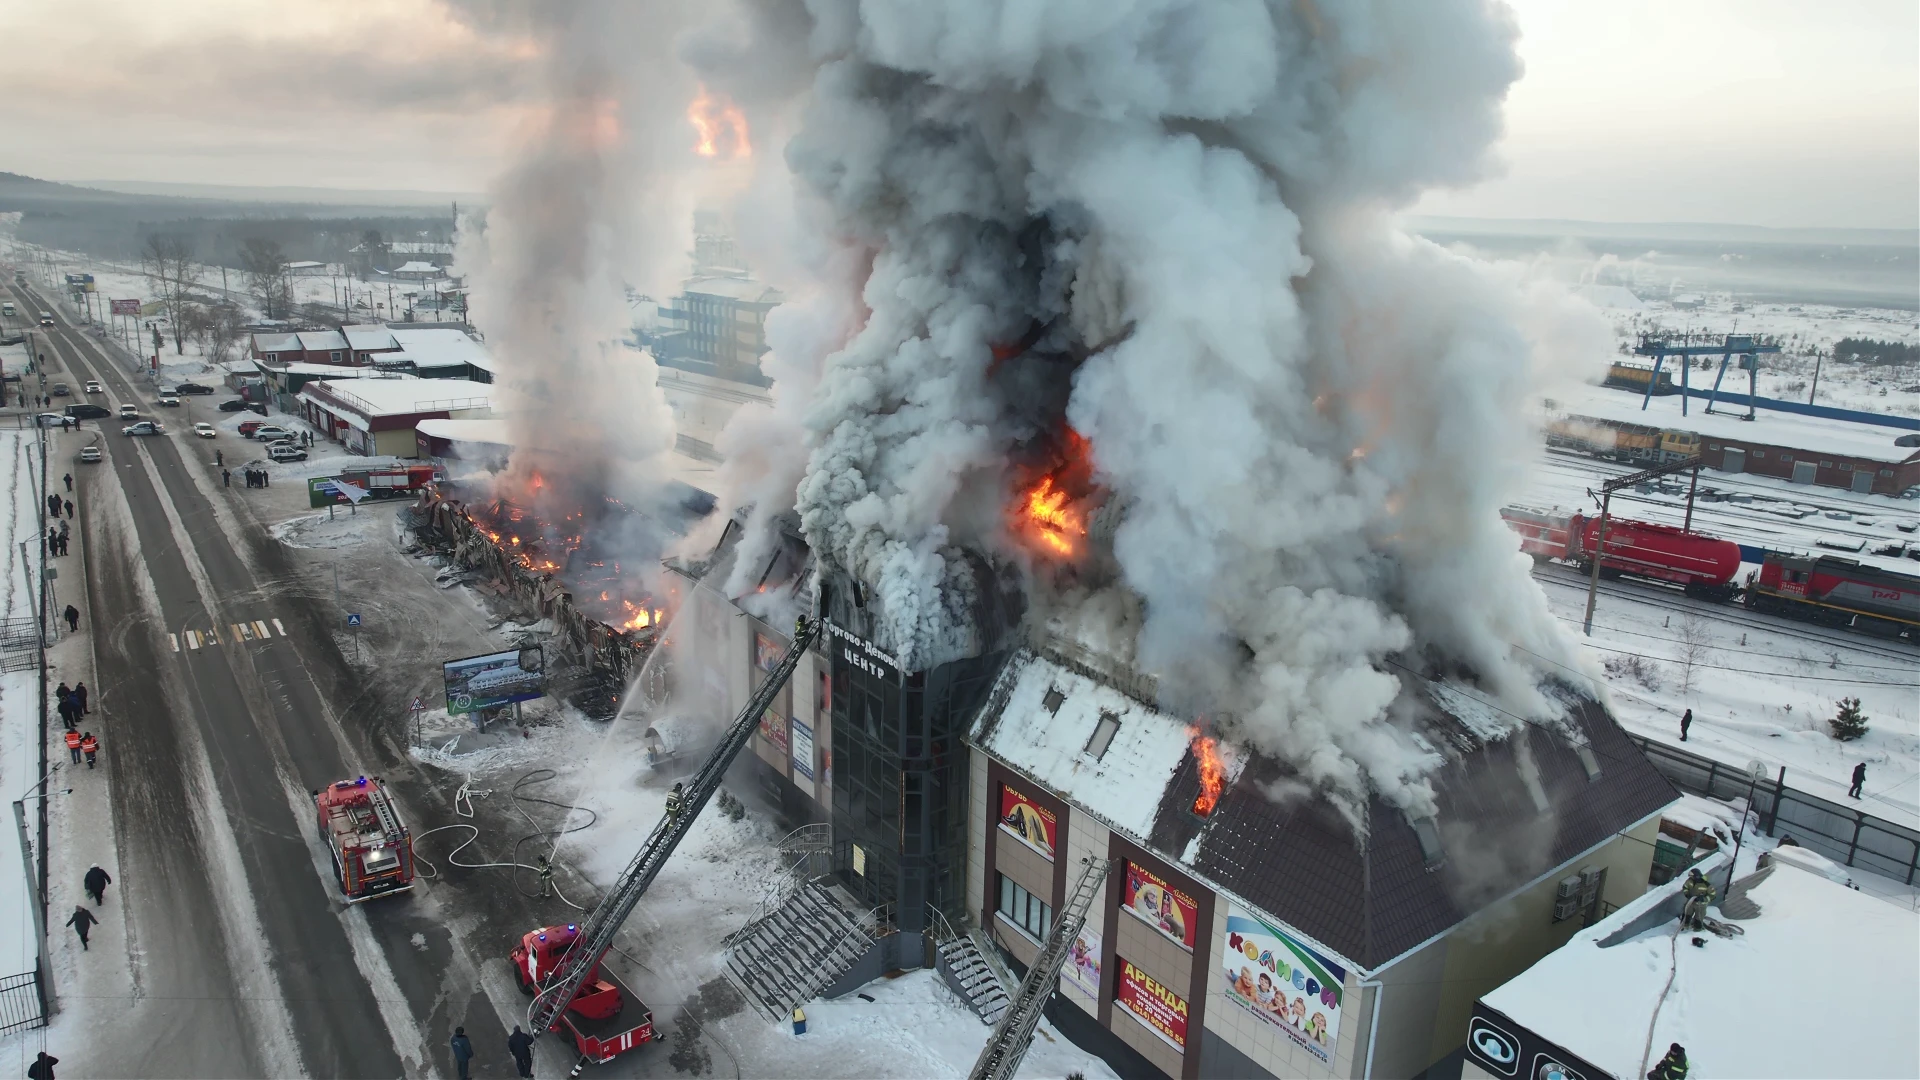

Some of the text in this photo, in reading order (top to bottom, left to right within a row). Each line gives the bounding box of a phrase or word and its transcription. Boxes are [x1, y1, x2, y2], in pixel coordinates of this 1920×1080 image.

[823, 617, 900, 669] Торгово-Делово
[844, 647, 885, 680] ЦЕНТР
[1125, 962, 1188, 1017] АРЕНДА
[1229, 931, 1337, 1010] КОЛИБРИ
[1123, 997, 1132, 1007] +7
[1125, 978, 1149, 998] офисов
[1154, 998, 1185, 1024] торговых
[1135, 992, 1173, 1022] помещений
[1136, 999, 1144, 1008] от
[1144, 1004, 1153, 1014] 20
